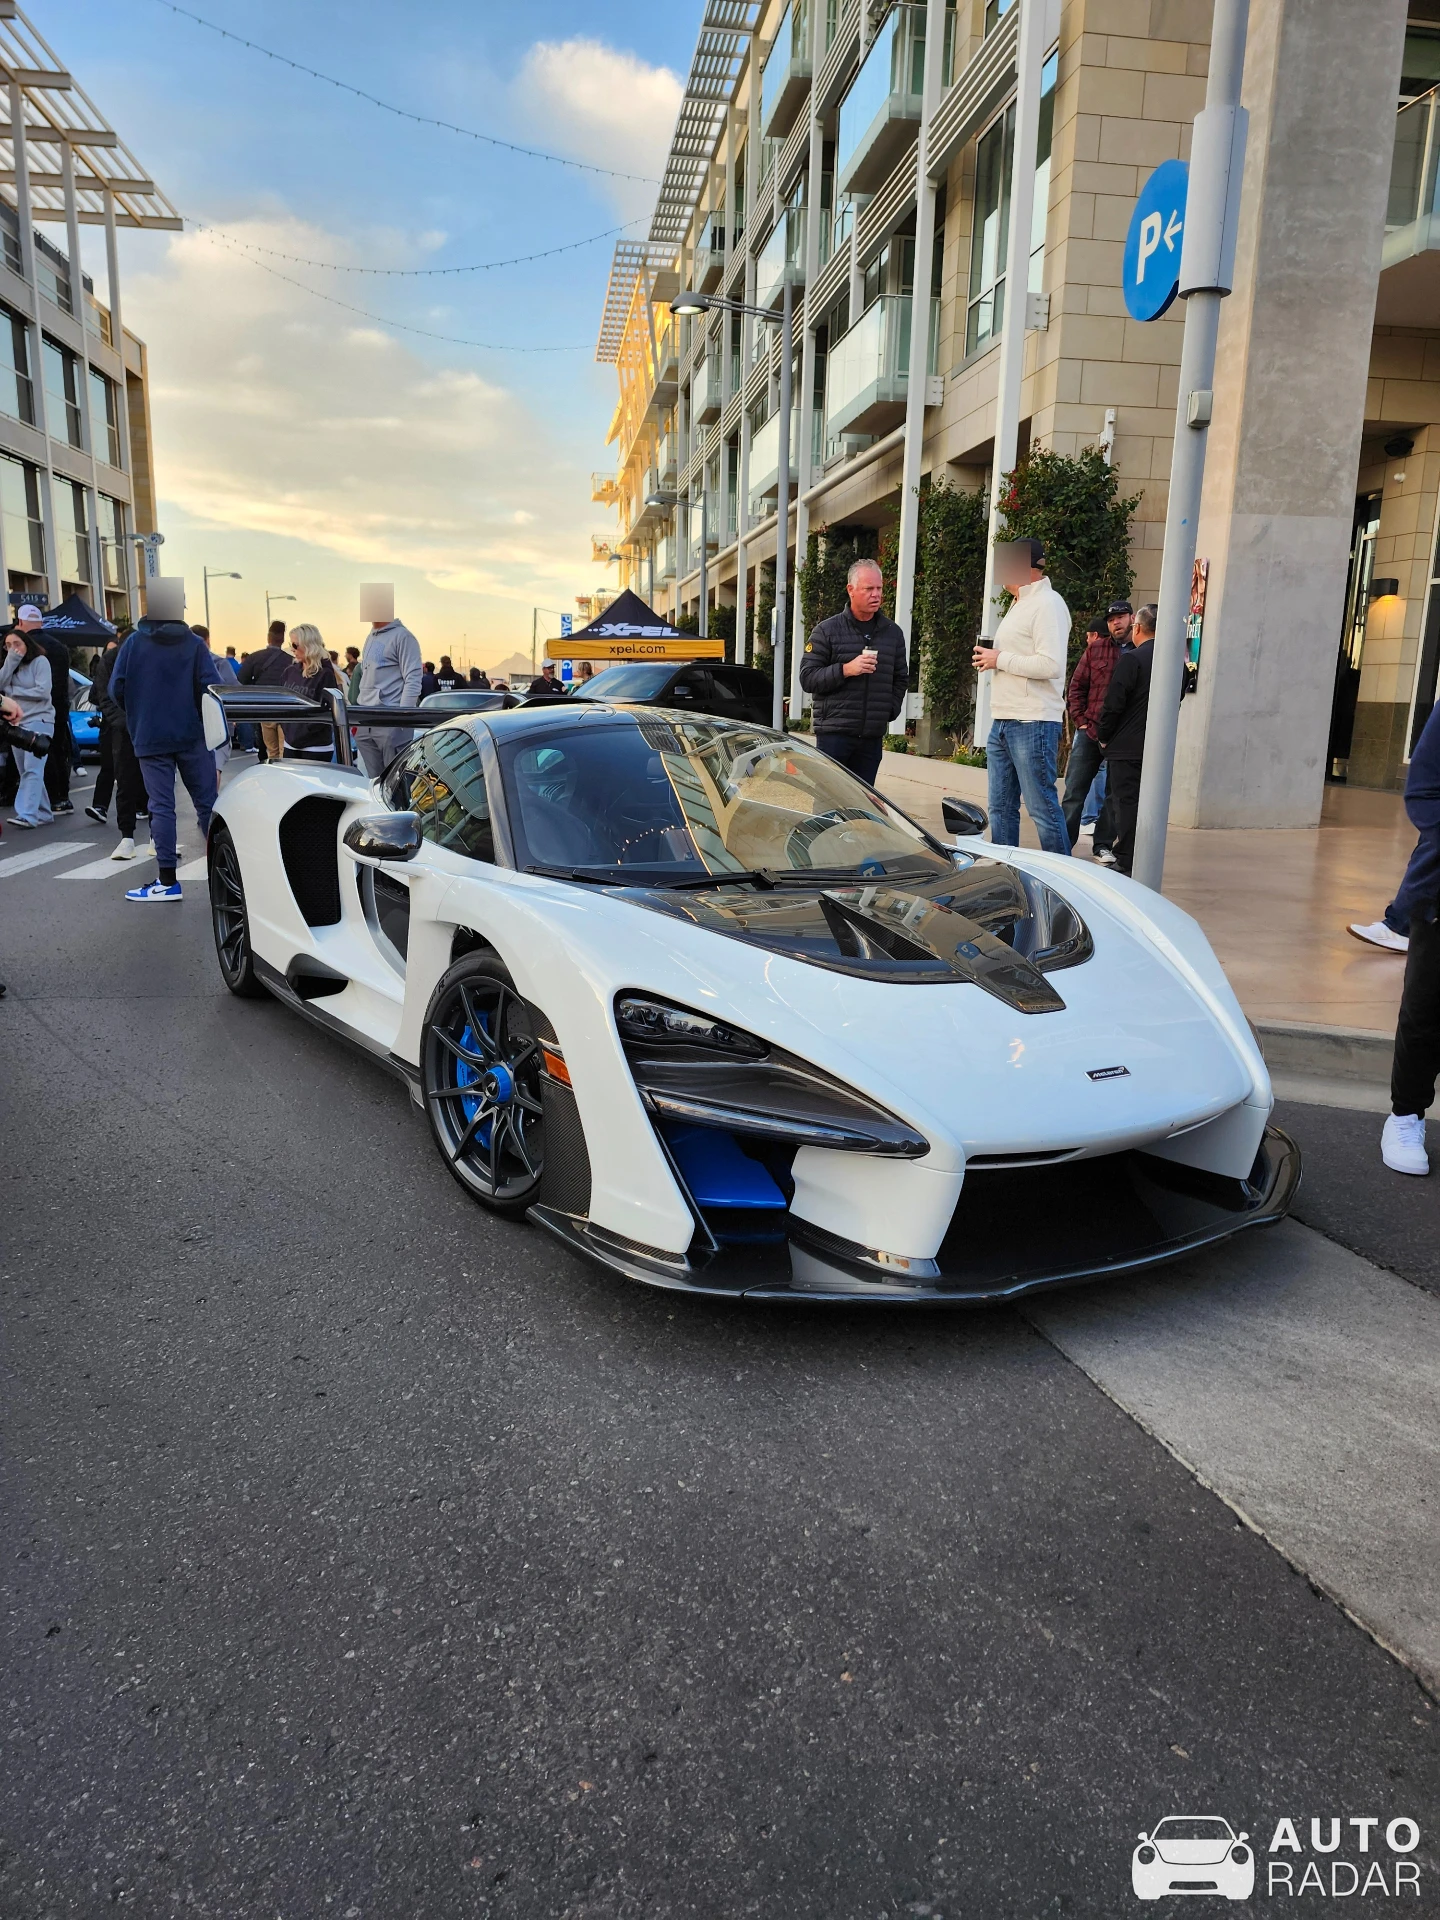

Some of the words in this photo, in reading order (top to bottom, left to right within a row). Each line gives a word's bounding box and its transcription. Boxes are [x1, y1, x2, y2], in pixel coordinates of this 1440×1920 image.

[1135, 211, 1162, 284] P
[599, 623, 680, 636] XPEL
[609, 644, 666, 655] xpel.com
